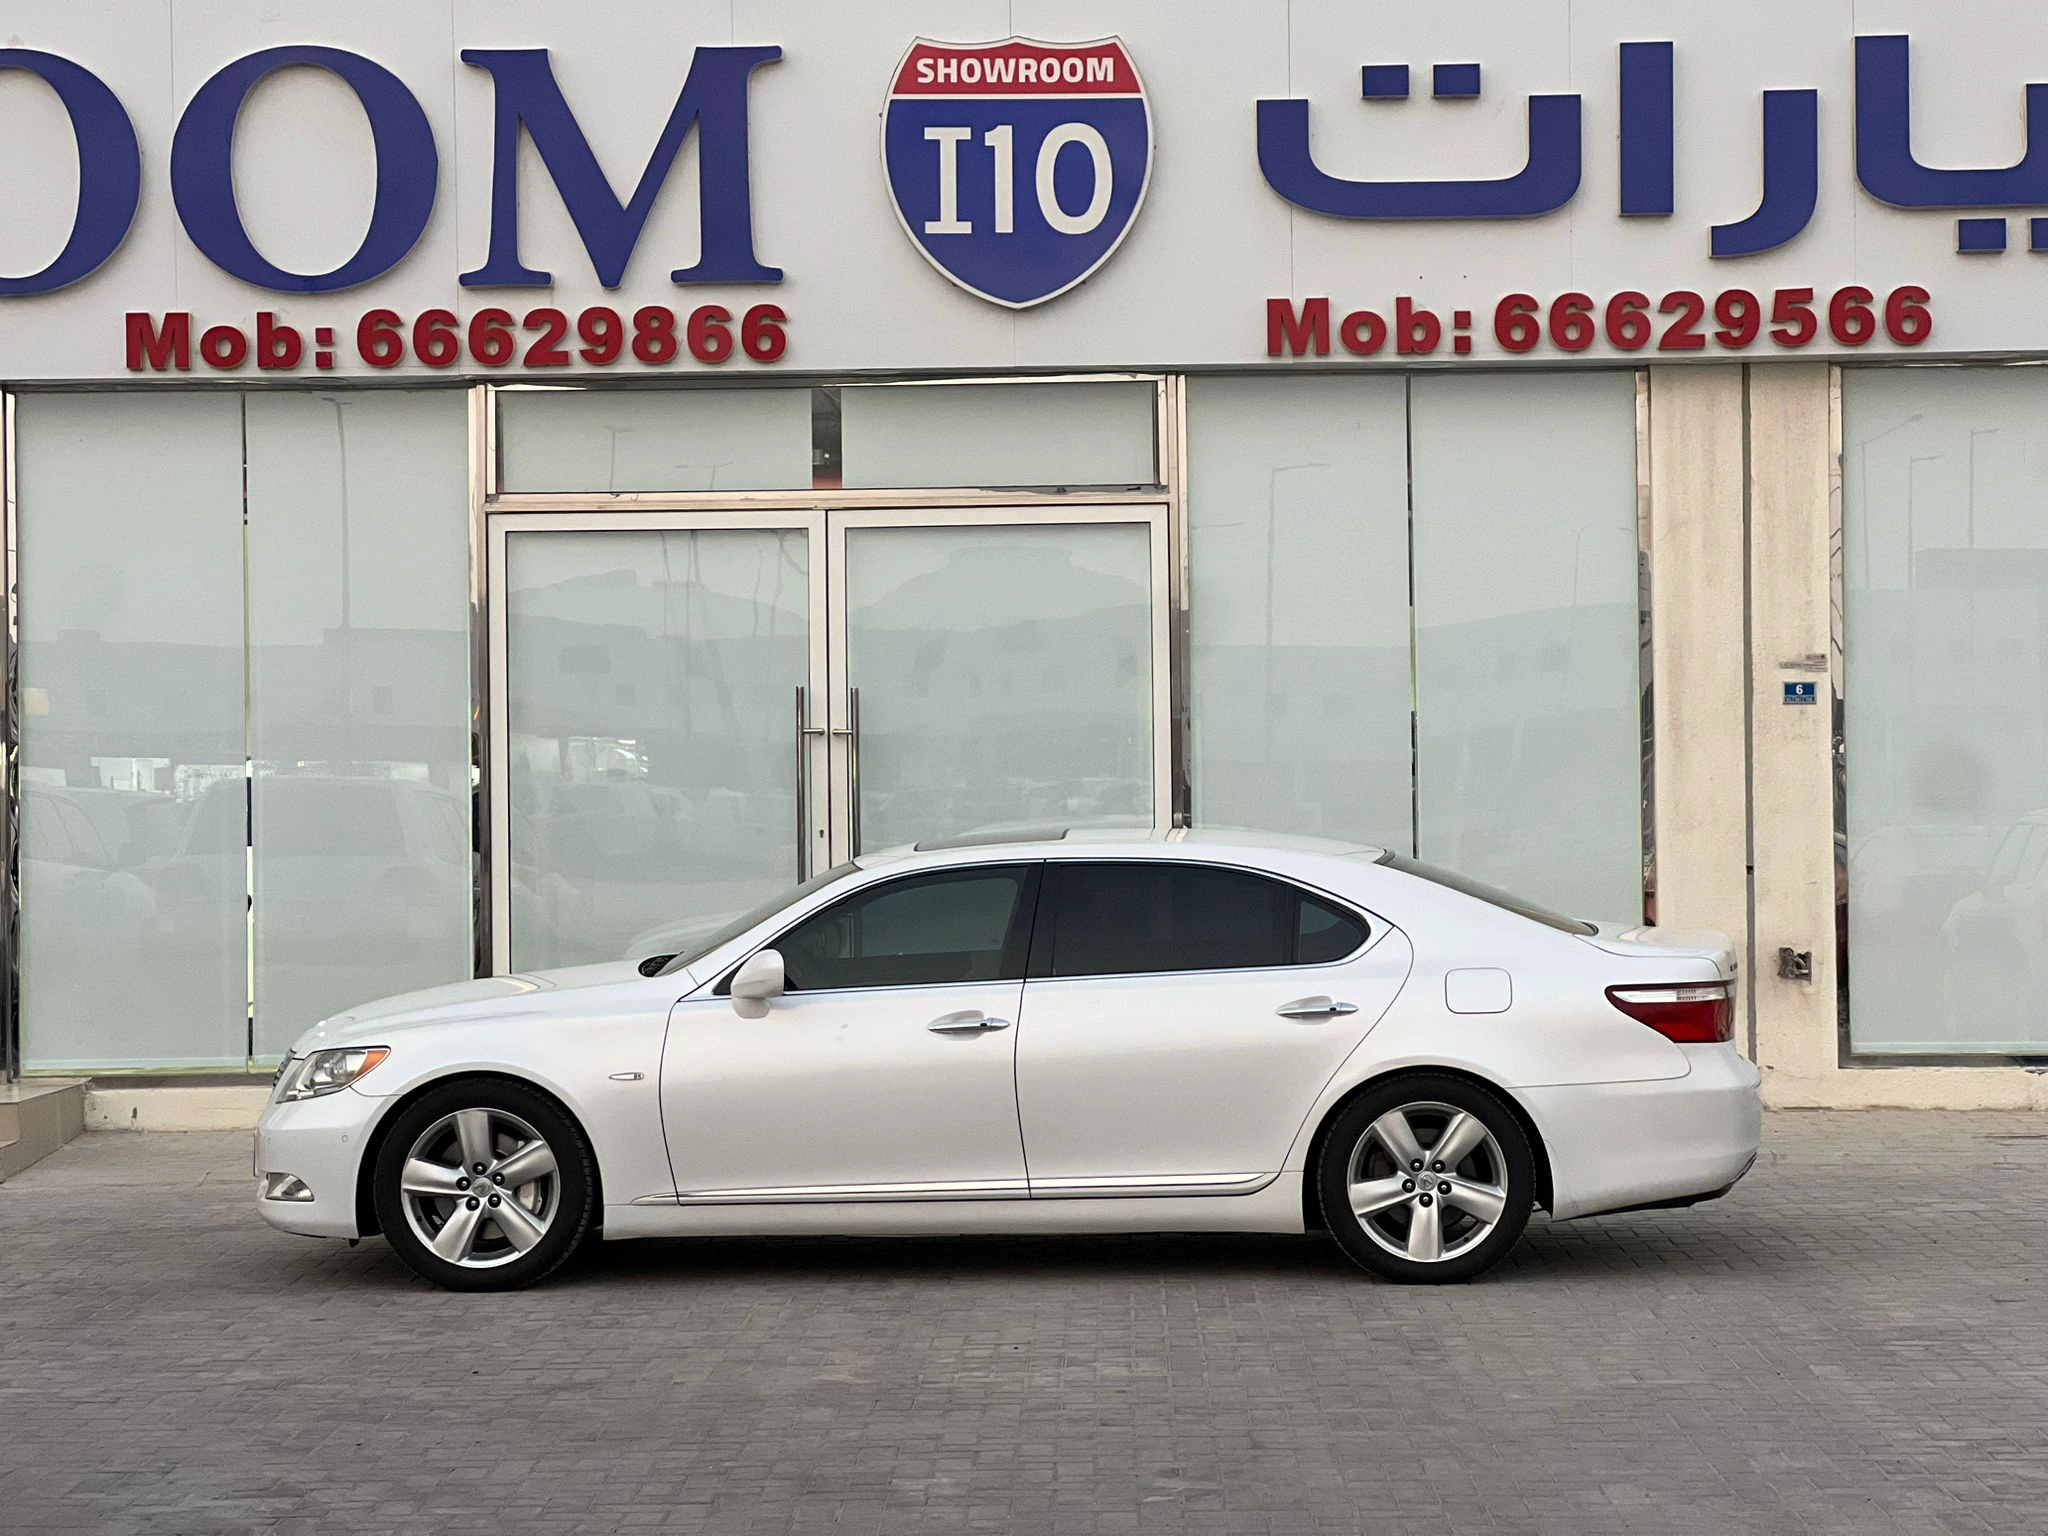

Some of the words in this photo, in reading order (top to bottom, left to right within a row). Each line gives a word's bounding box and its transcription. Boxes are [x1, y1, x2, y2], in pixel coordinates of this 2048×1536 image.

[916, 56, 1115, 84] SHOWROOM
[923, 121, 1114, 235] I10
[125, 311, 334, 371] Mob:
[356, 303, 788, 369] 66629866
[1266, 296, 1472, 356] Mob:
[1493, 285, 1933, 353] 66629566
[1795, 684, 1804, 695] 6
